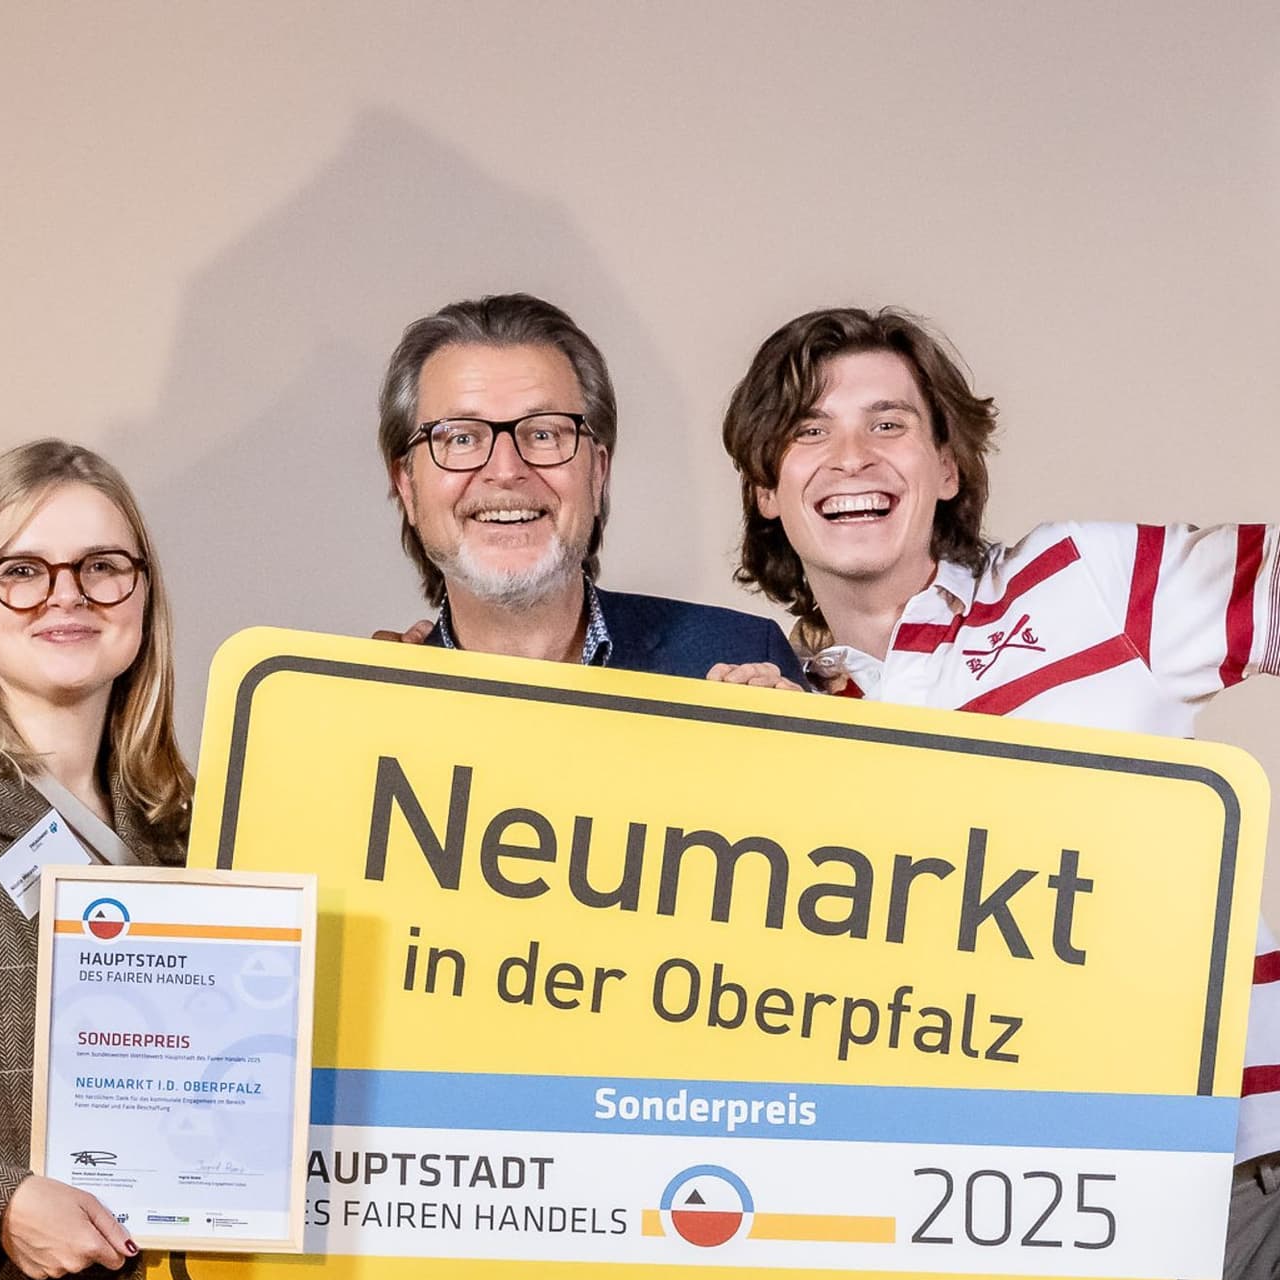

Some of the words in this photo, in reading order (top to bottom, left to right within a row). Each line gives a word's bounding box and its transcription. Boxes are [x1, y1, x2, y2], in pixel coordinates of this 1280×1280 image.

[364, 756, 1094, 966] Neumarkt
[80, 952, 187, 968] HAUPTSTADT
[79, 970, 102, 982] DES
[107, 971, 153, 984] FAIREN
[156, 973, 216, 986] HANDELS
[403, 927, 466, 997] in
[497, 941, 627, 1014] der
[651, 957, 1024, 1064] Oberpfalz
[78, 1032, 190, 1049] SONDERPREIS
[76, 1077, 153, 1090] NEUMARKT
[158, 1080, 179, 1091] I.D.
[183, 1081, 262, 1094] OBERPFALZ
[594, 1087, 817, 1131] Sonderpreis
[307, 1150, 554, 1190] AUPTSTADT
[911, 1167, 1117, 1250] 2025
[344, 1200, 461, 1231] FAIREN
[475, 1204, 628, 1235] HANDELS
